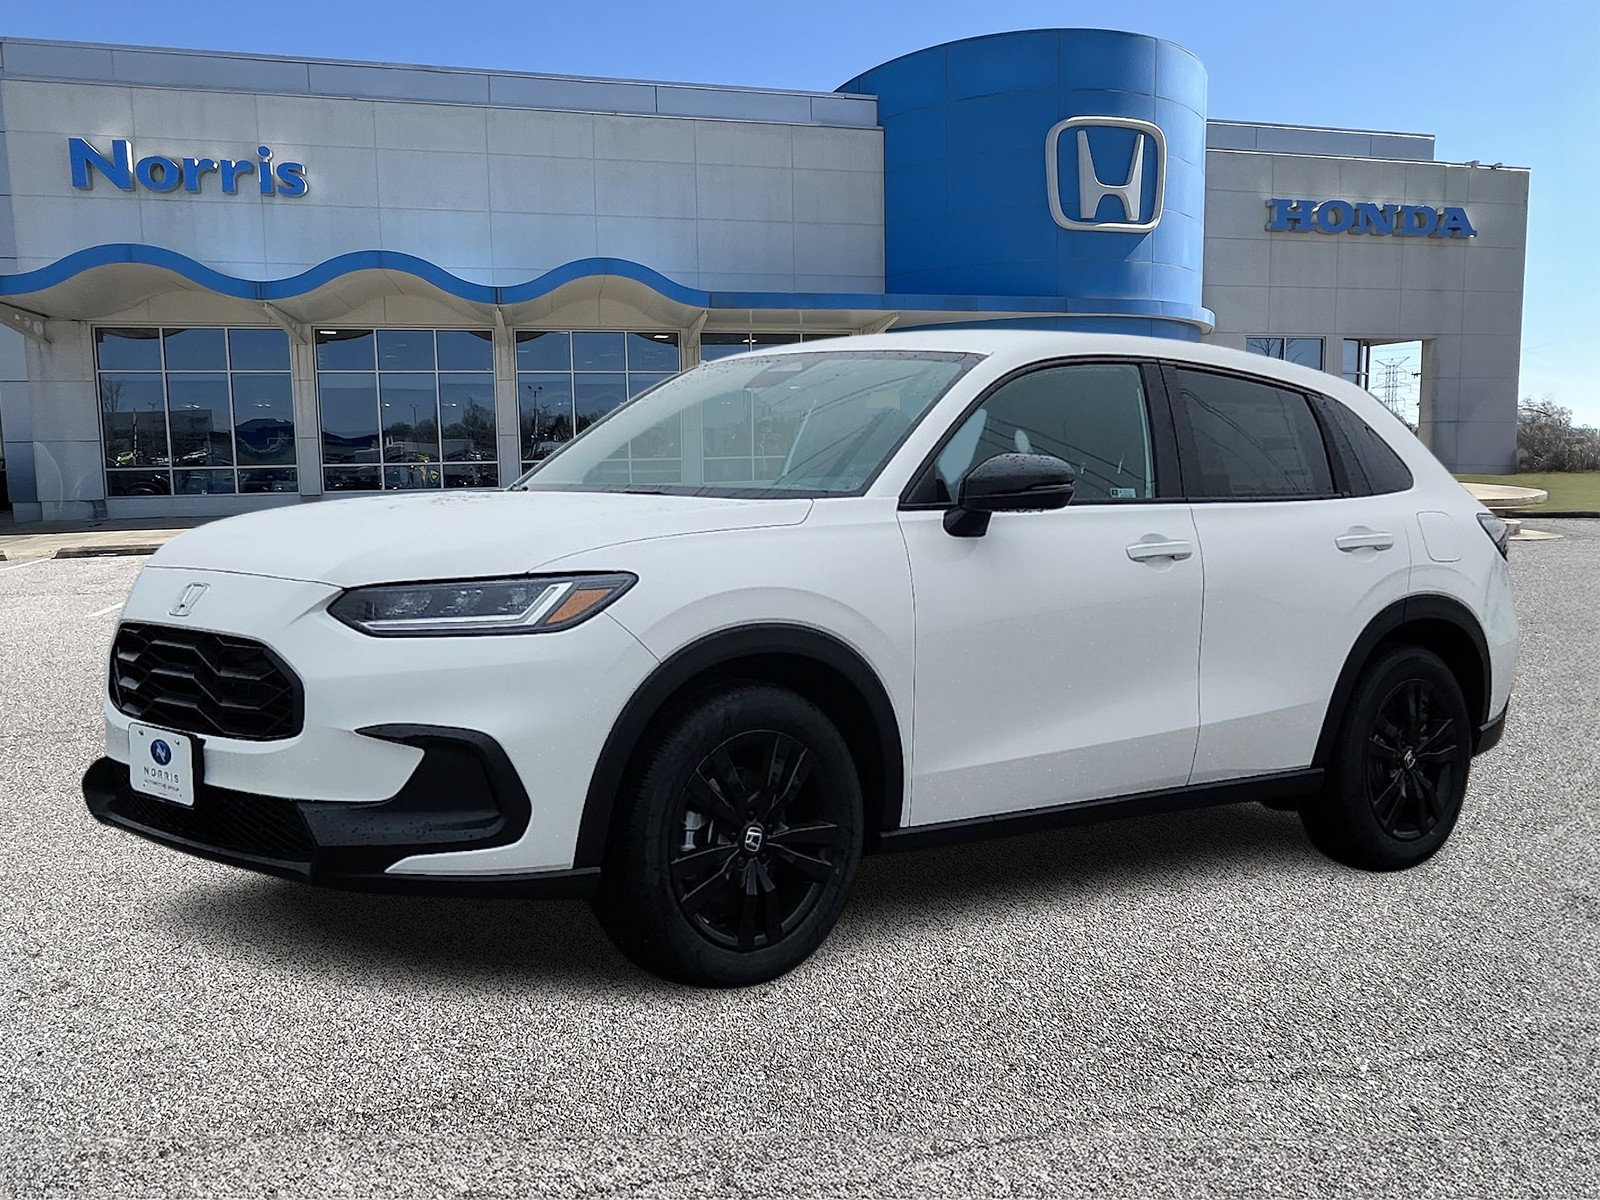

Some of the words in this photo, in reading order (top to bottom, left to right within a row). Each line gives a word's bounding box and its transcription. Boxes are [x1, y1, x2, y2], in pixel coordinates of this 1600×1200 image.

[68, 137, 308, 197] Norris
[1267, 198, 1477, 238] HONDA
[144, 766, 179, 783] NORRIS
